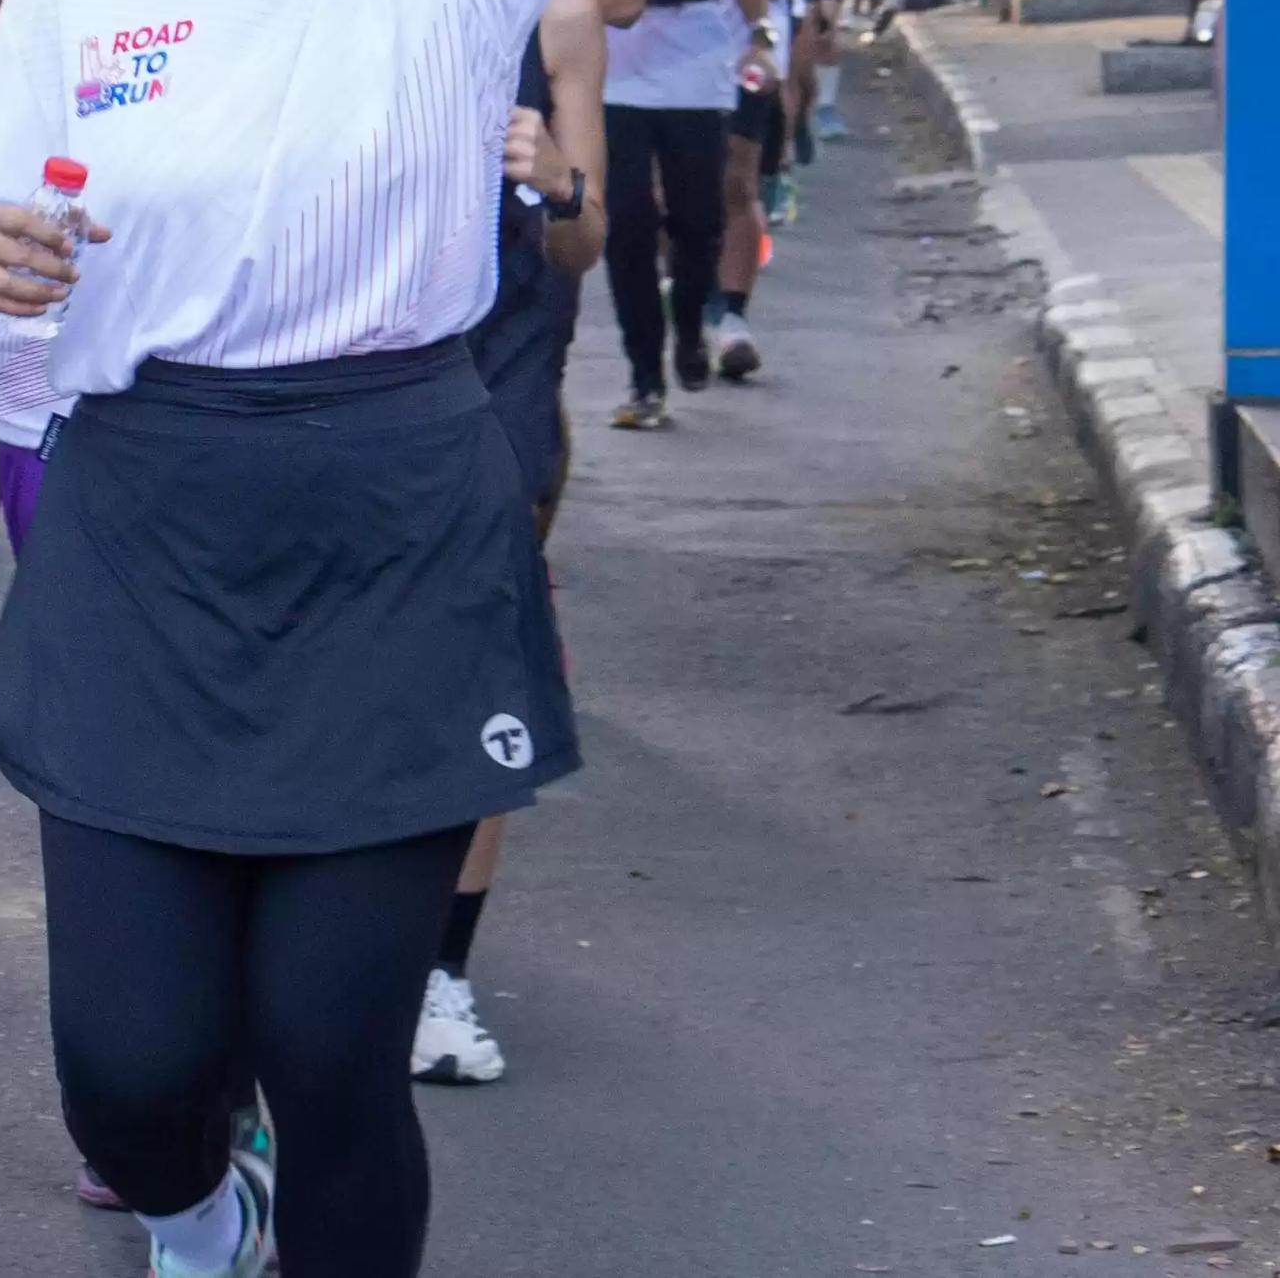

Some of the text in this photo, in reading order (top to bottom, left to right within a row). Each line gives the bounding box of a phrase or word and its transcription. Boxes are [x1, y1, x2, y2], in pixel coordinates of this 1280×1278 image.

[112, 20, 193, 55] ROAD
[132, 51, 168, 77] TO
[110, 80, 167, 106] RUN
